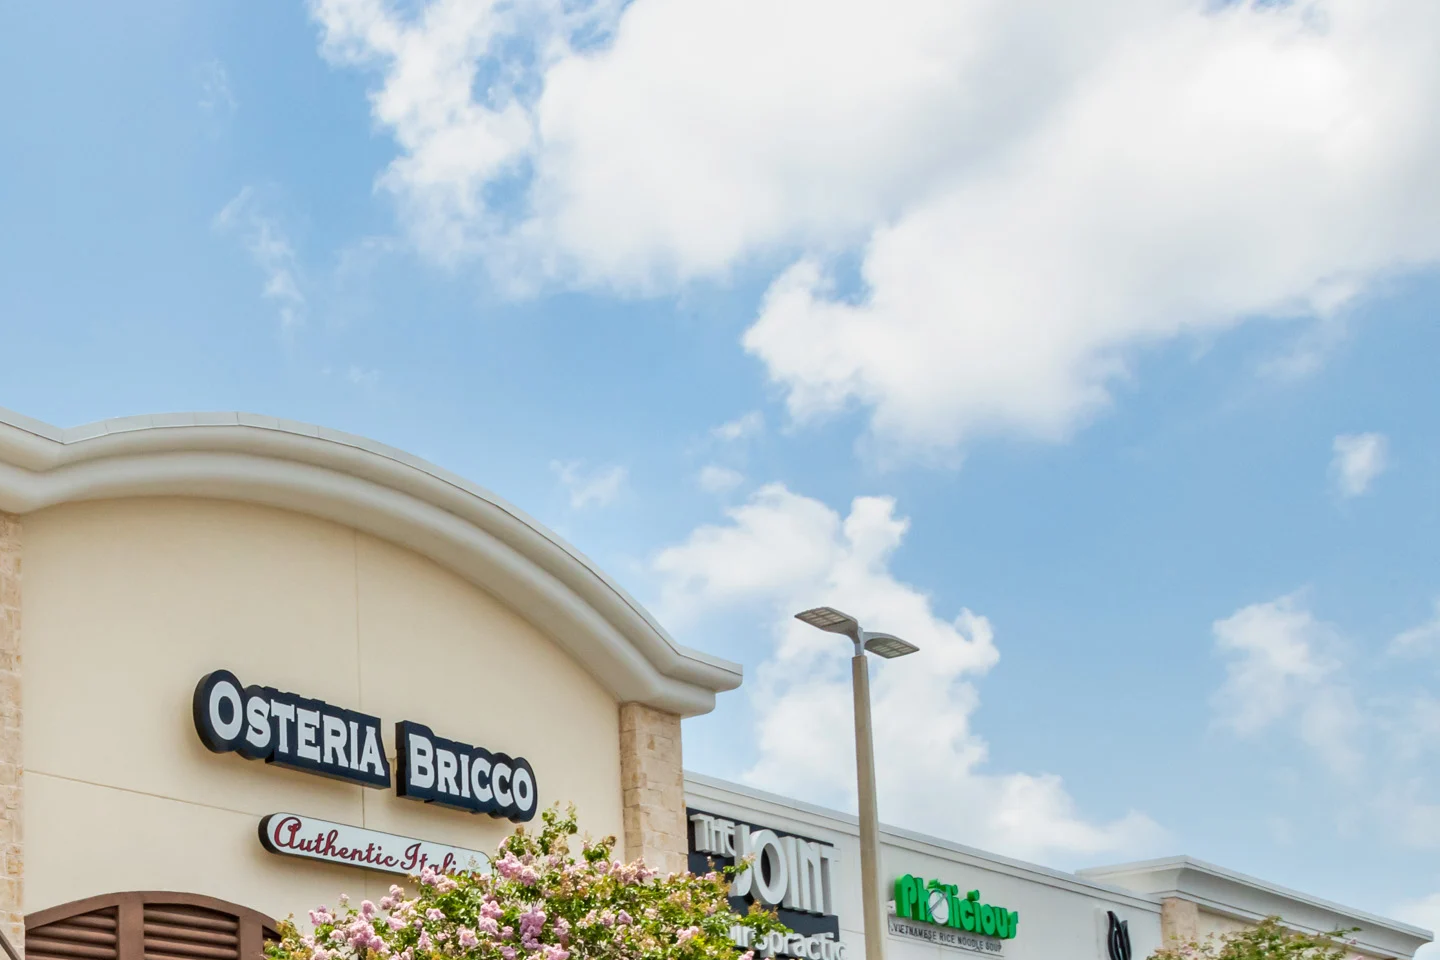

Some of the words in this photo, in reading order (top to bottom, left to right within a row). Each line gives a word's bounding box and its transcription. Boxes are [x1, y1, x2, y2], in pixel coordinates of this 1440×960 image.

[208, 680, 386, 777] OSTERIA
[408, 733, 534, 812] BRICCO
[273, 816, 400, 868] Authentic
[400, 842, 478, 876] Itali
[728, 824, 841, 917] JOINT
[892, 922, 937, 941] VIETNAMESE
[939, 932, 956, 944] RICE
[957, 936, 984, 951] NOODLE
[985, 942, 1003, 953] SOUP
